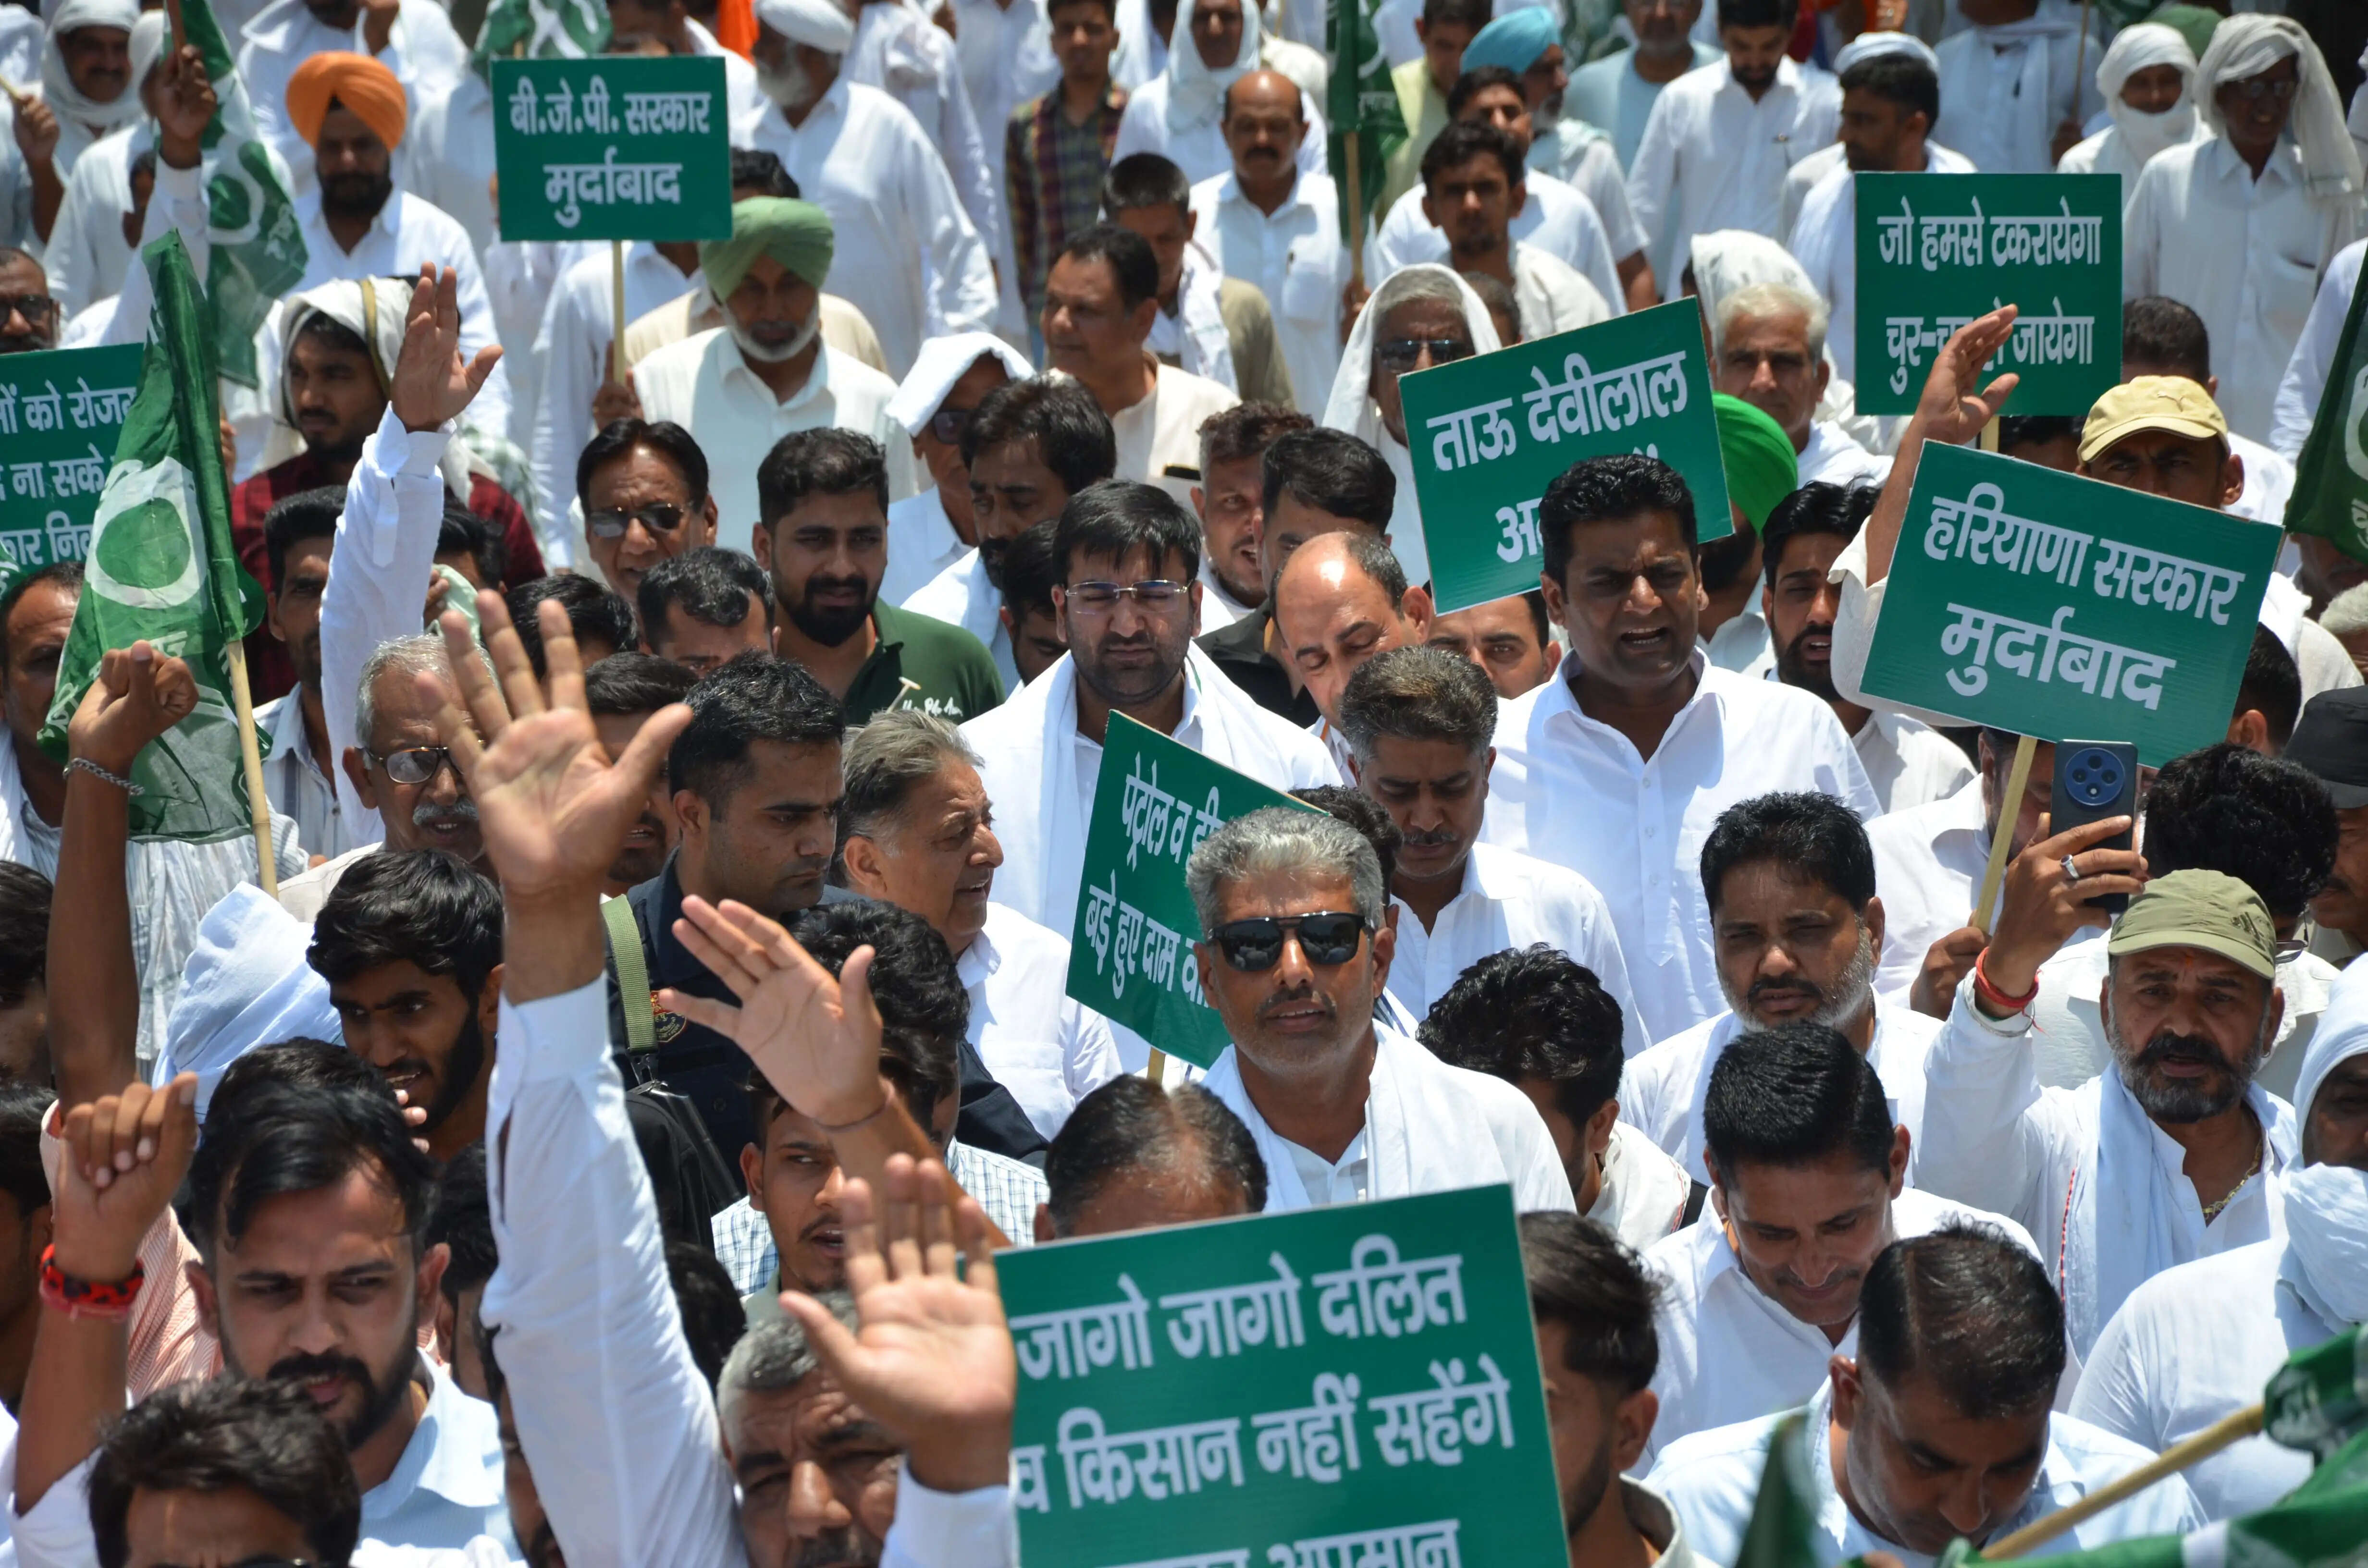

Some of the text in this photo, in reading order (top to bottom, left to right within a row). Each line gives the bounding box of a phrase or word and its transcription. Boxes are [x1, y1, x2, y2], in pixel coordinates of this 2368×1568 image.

[508, 75, 711, 135] बी.जे.पी. सरकार
[543, 146, 682, 228] मुर्दाबाद
[1877, 195, 2103, 271] जो हमसे टकरायेगा
[2012, 296, 2095, 365] जायेगा
[22, 379, 64, 431] को
[1426, 350, 1688, 472] ताऊ देवीलाल
[9, 462, 46, 498] ना
[49, 442, 105, 497] सके
[1924, 482, 2245, 625] हरियाणा सरकार
[1941, 602, 2176, 710] मुर्दाबाद
[1170, 800, 1193, 864] व
[1112, 901, 1144, 999] हुए
[1143, 917, 1181, 991] दाम
[1009, 1235, 1467, 1381] जागो जागो दलित
[1057, 1408, 1245, 1508] किसान
[1251, 1372, 1361, 1483] नहीं
[1368, 1353, 1515, 1466] सहेंगे
